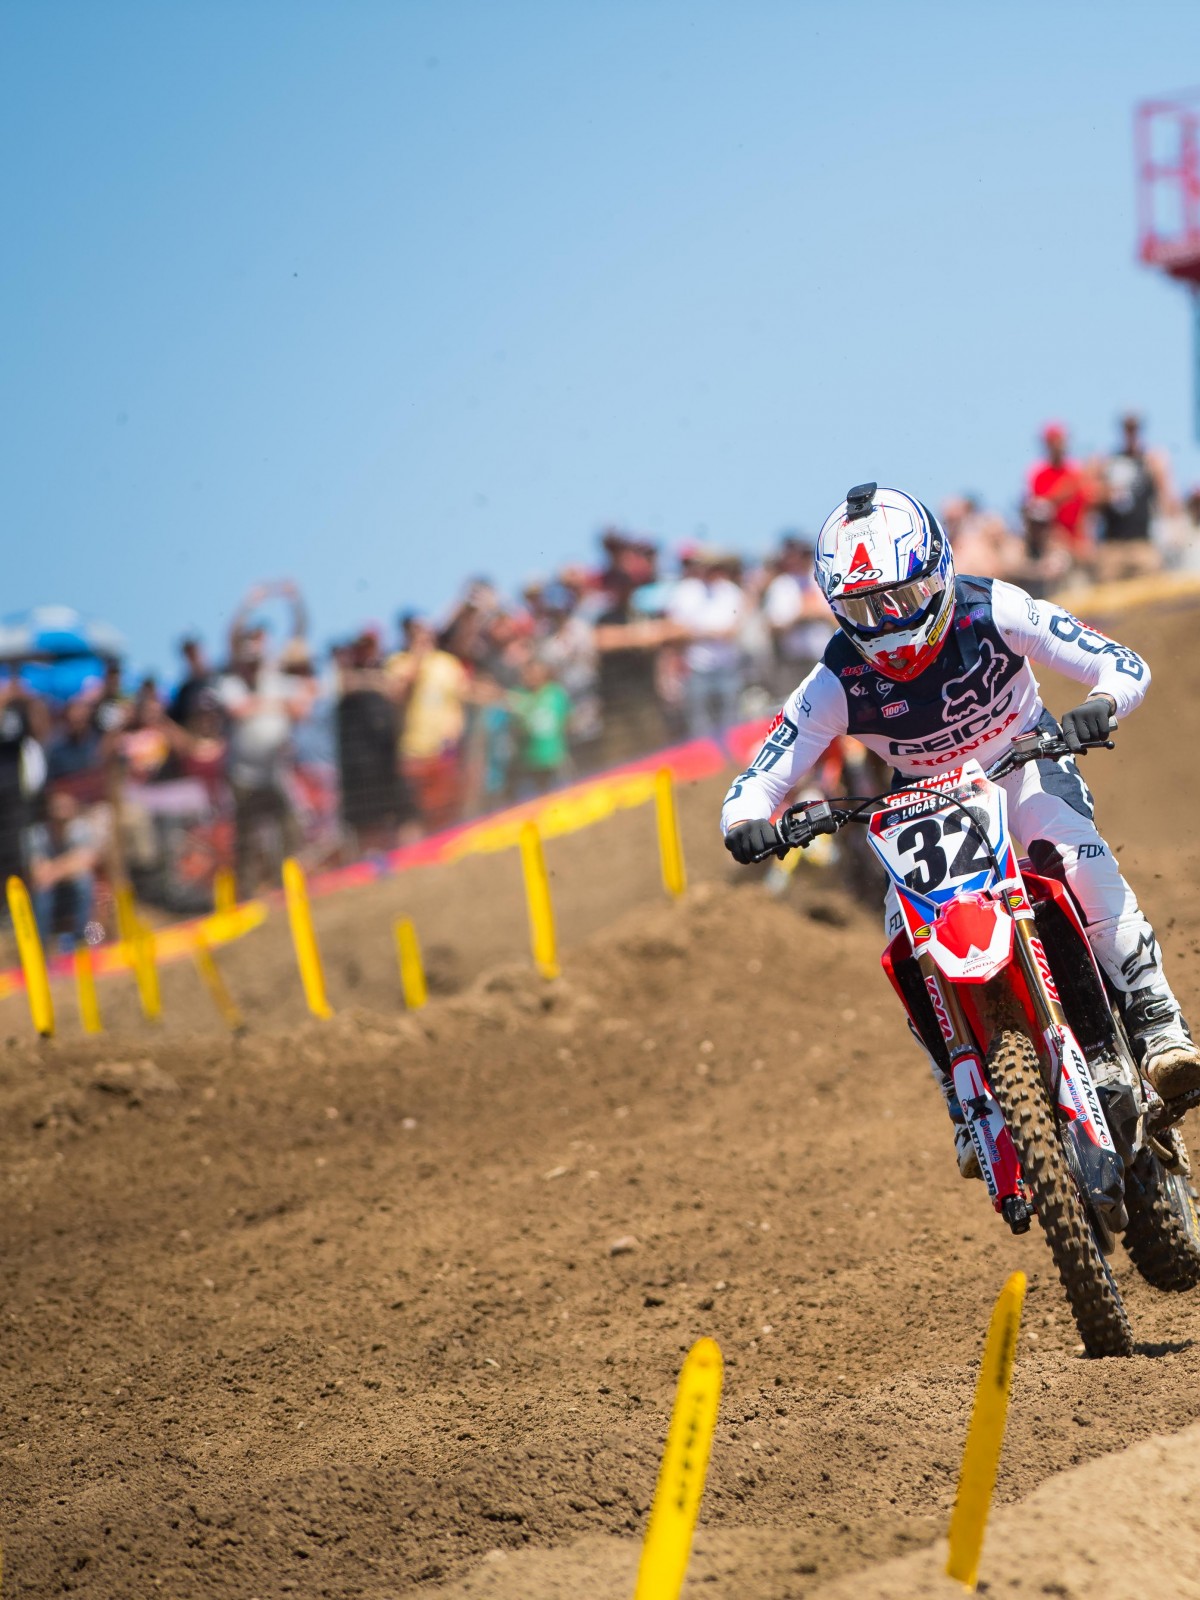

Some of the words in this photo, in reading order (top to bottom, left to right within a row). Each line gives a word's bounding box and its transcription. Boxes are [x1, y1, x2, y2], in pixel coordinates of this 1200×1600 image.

[842, 564, 883, 584] 6D
[884, 702, 906, 717] 100%
[888, 690, 1013, 756] GEICO
[910, 712, 1019, 766] HONDA
[902, 798, 937, 820] LUCAS
[897, 806, 992, 895] 32
[1077, 844, 1105, 860] FOX
[889, 910, 905, 936] FO
[962, 960, 995, 976] HONDA
[1070, 1049, 1105, 1127] DUNLOP
